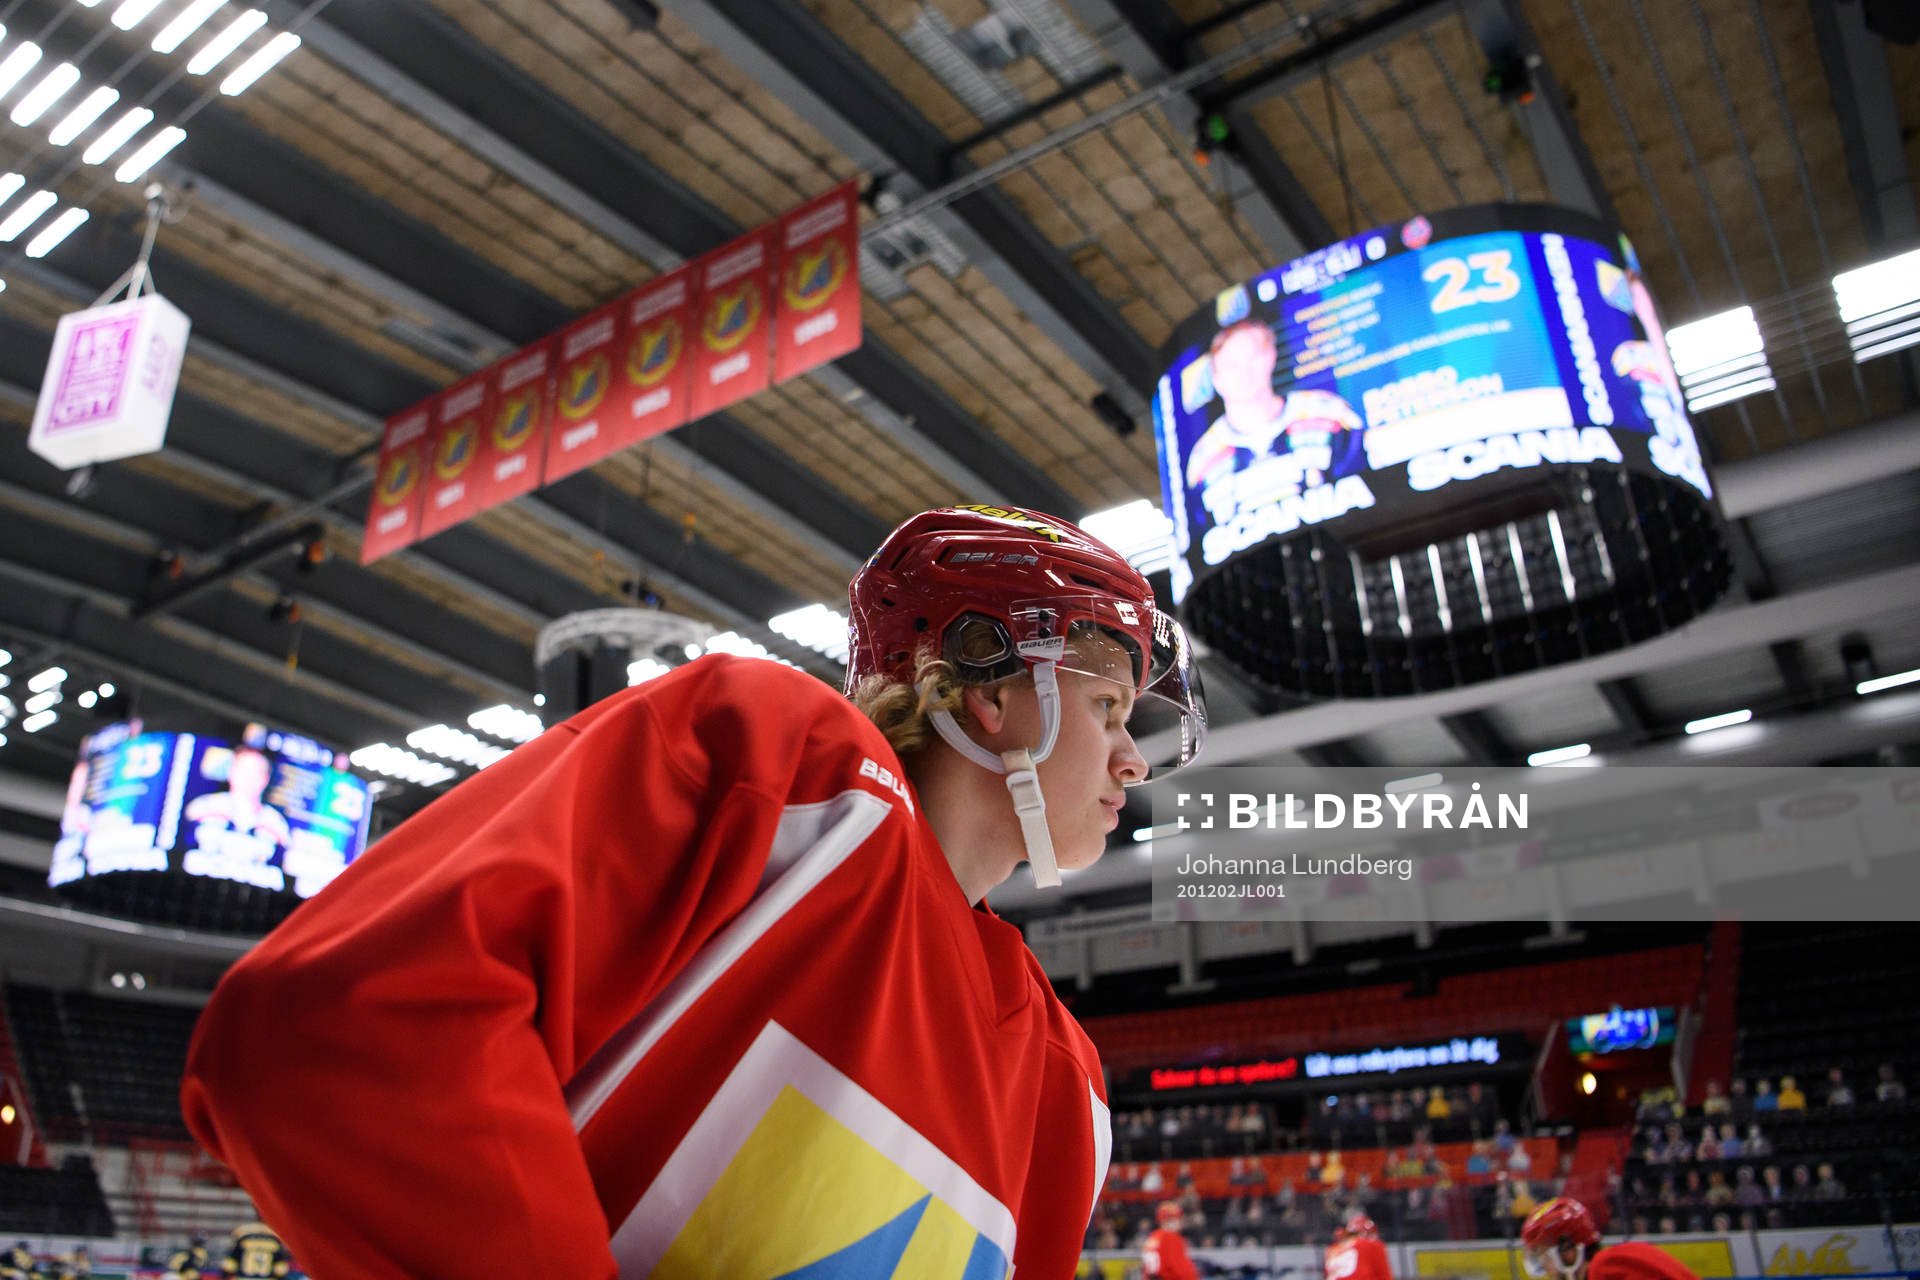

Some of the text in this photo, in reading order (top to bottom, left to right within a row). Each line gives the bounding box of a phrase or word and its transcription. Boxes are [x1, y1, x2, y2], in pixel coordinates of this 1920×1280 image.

[1421, 250, 1521, 314] 23
[1407, 426, 1623, 492] SCANIA
[859, 757, 915, 822] BAU
